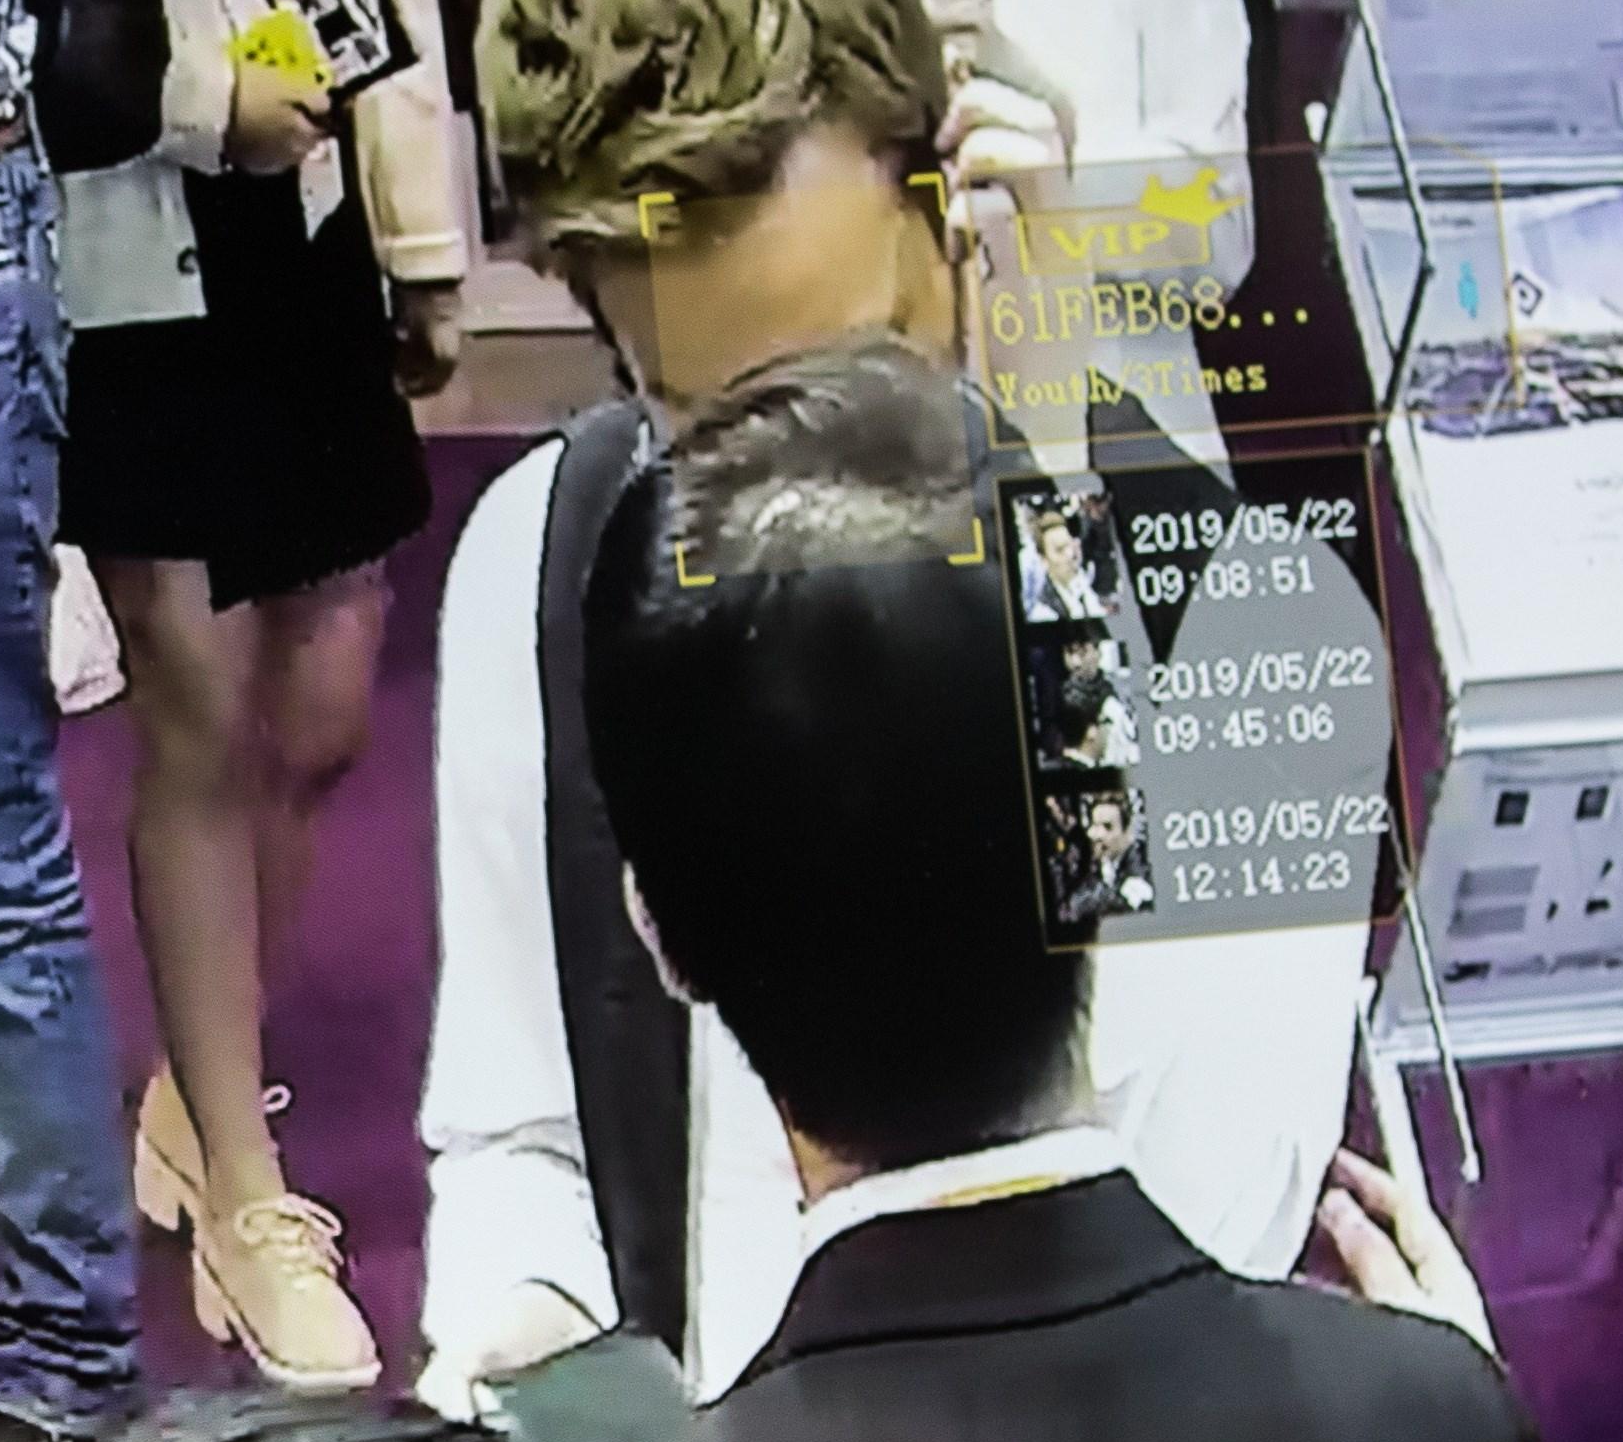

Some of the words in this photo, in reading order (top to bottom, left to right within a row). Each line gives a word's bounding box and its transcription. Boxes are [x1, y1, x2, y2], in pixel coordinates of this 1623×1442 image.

[1048, 221, 1171, 259] VIP
[1133, 501, 1356, 554] 2019/05/22
[1136, 559, 1315, 606] 09:08:51
[1149, 648, 1374, 703] 2019/05/22
[1155, 705, 1336, 753] 09:45:06
[1165, 797, 1390, 852] 2019/05/22
[1174, 854, 1352, 902] 12:14:23
